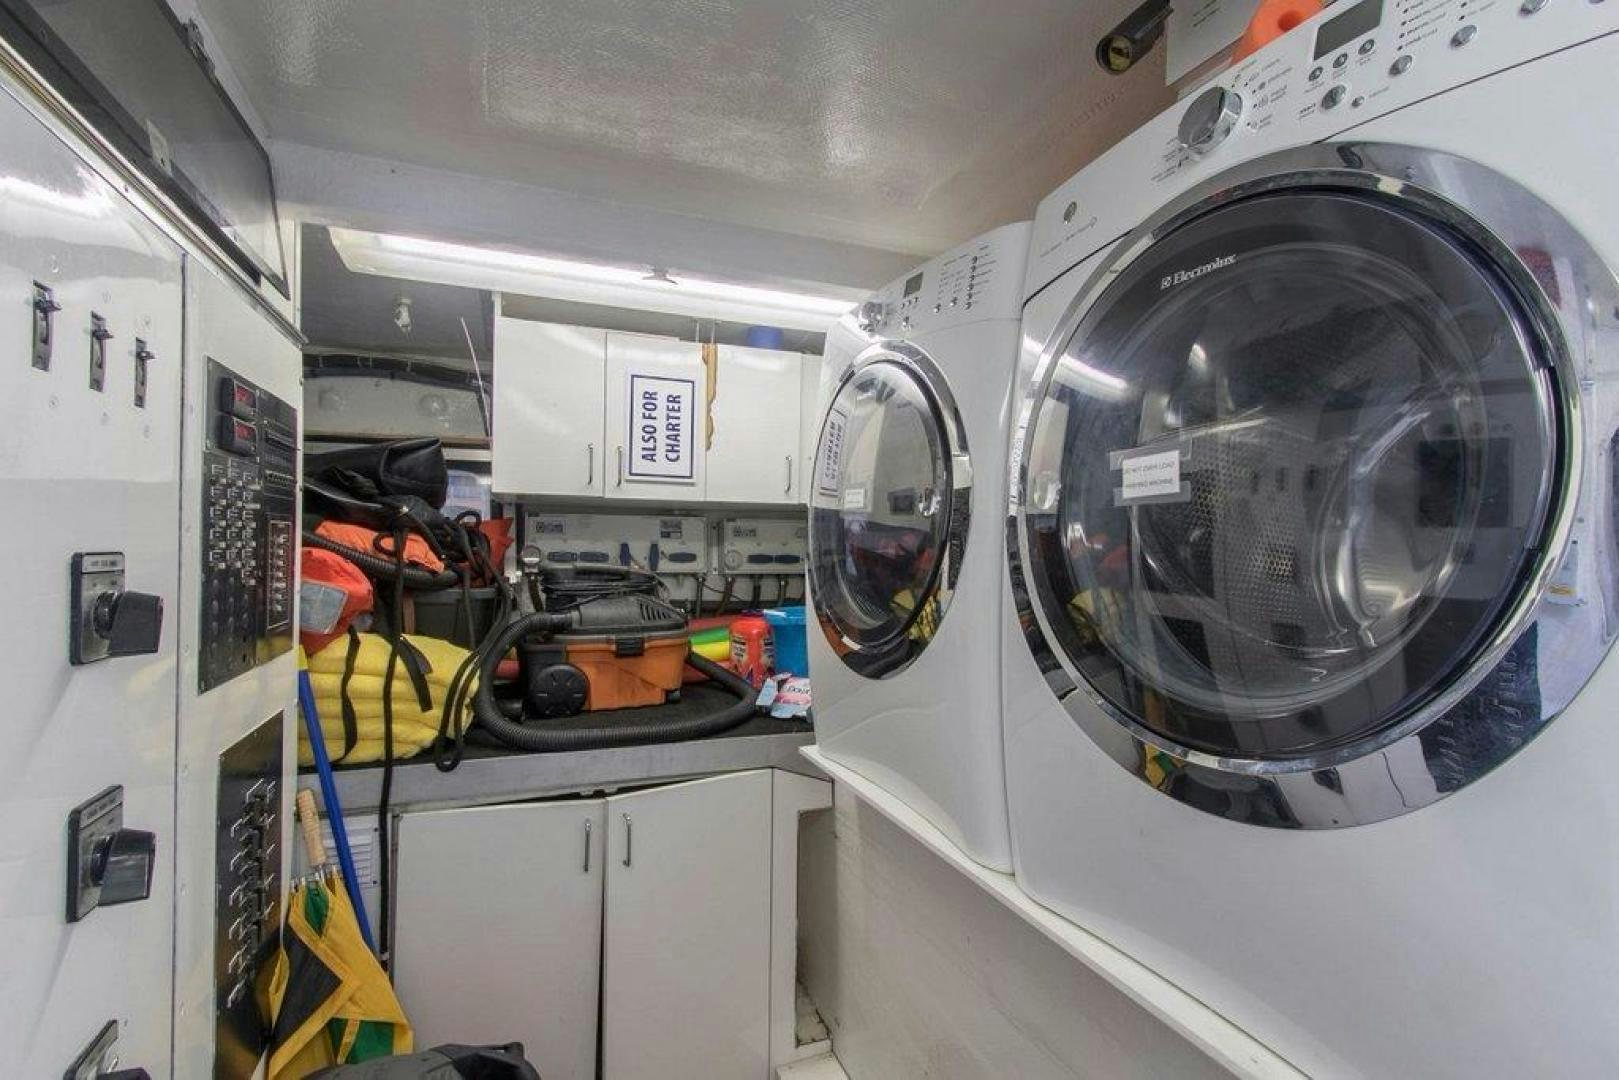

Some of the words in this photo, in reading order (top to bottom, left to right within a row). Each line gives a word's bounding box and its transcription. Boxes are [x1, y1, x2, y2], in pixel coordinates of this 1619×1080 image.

[1172, 253, 1237, 286] Electrolux
[641, 391, 659, 421] FOR
[641, 424, 657, 463] ALSO
[665, 394, 682, 463] CHARTER
